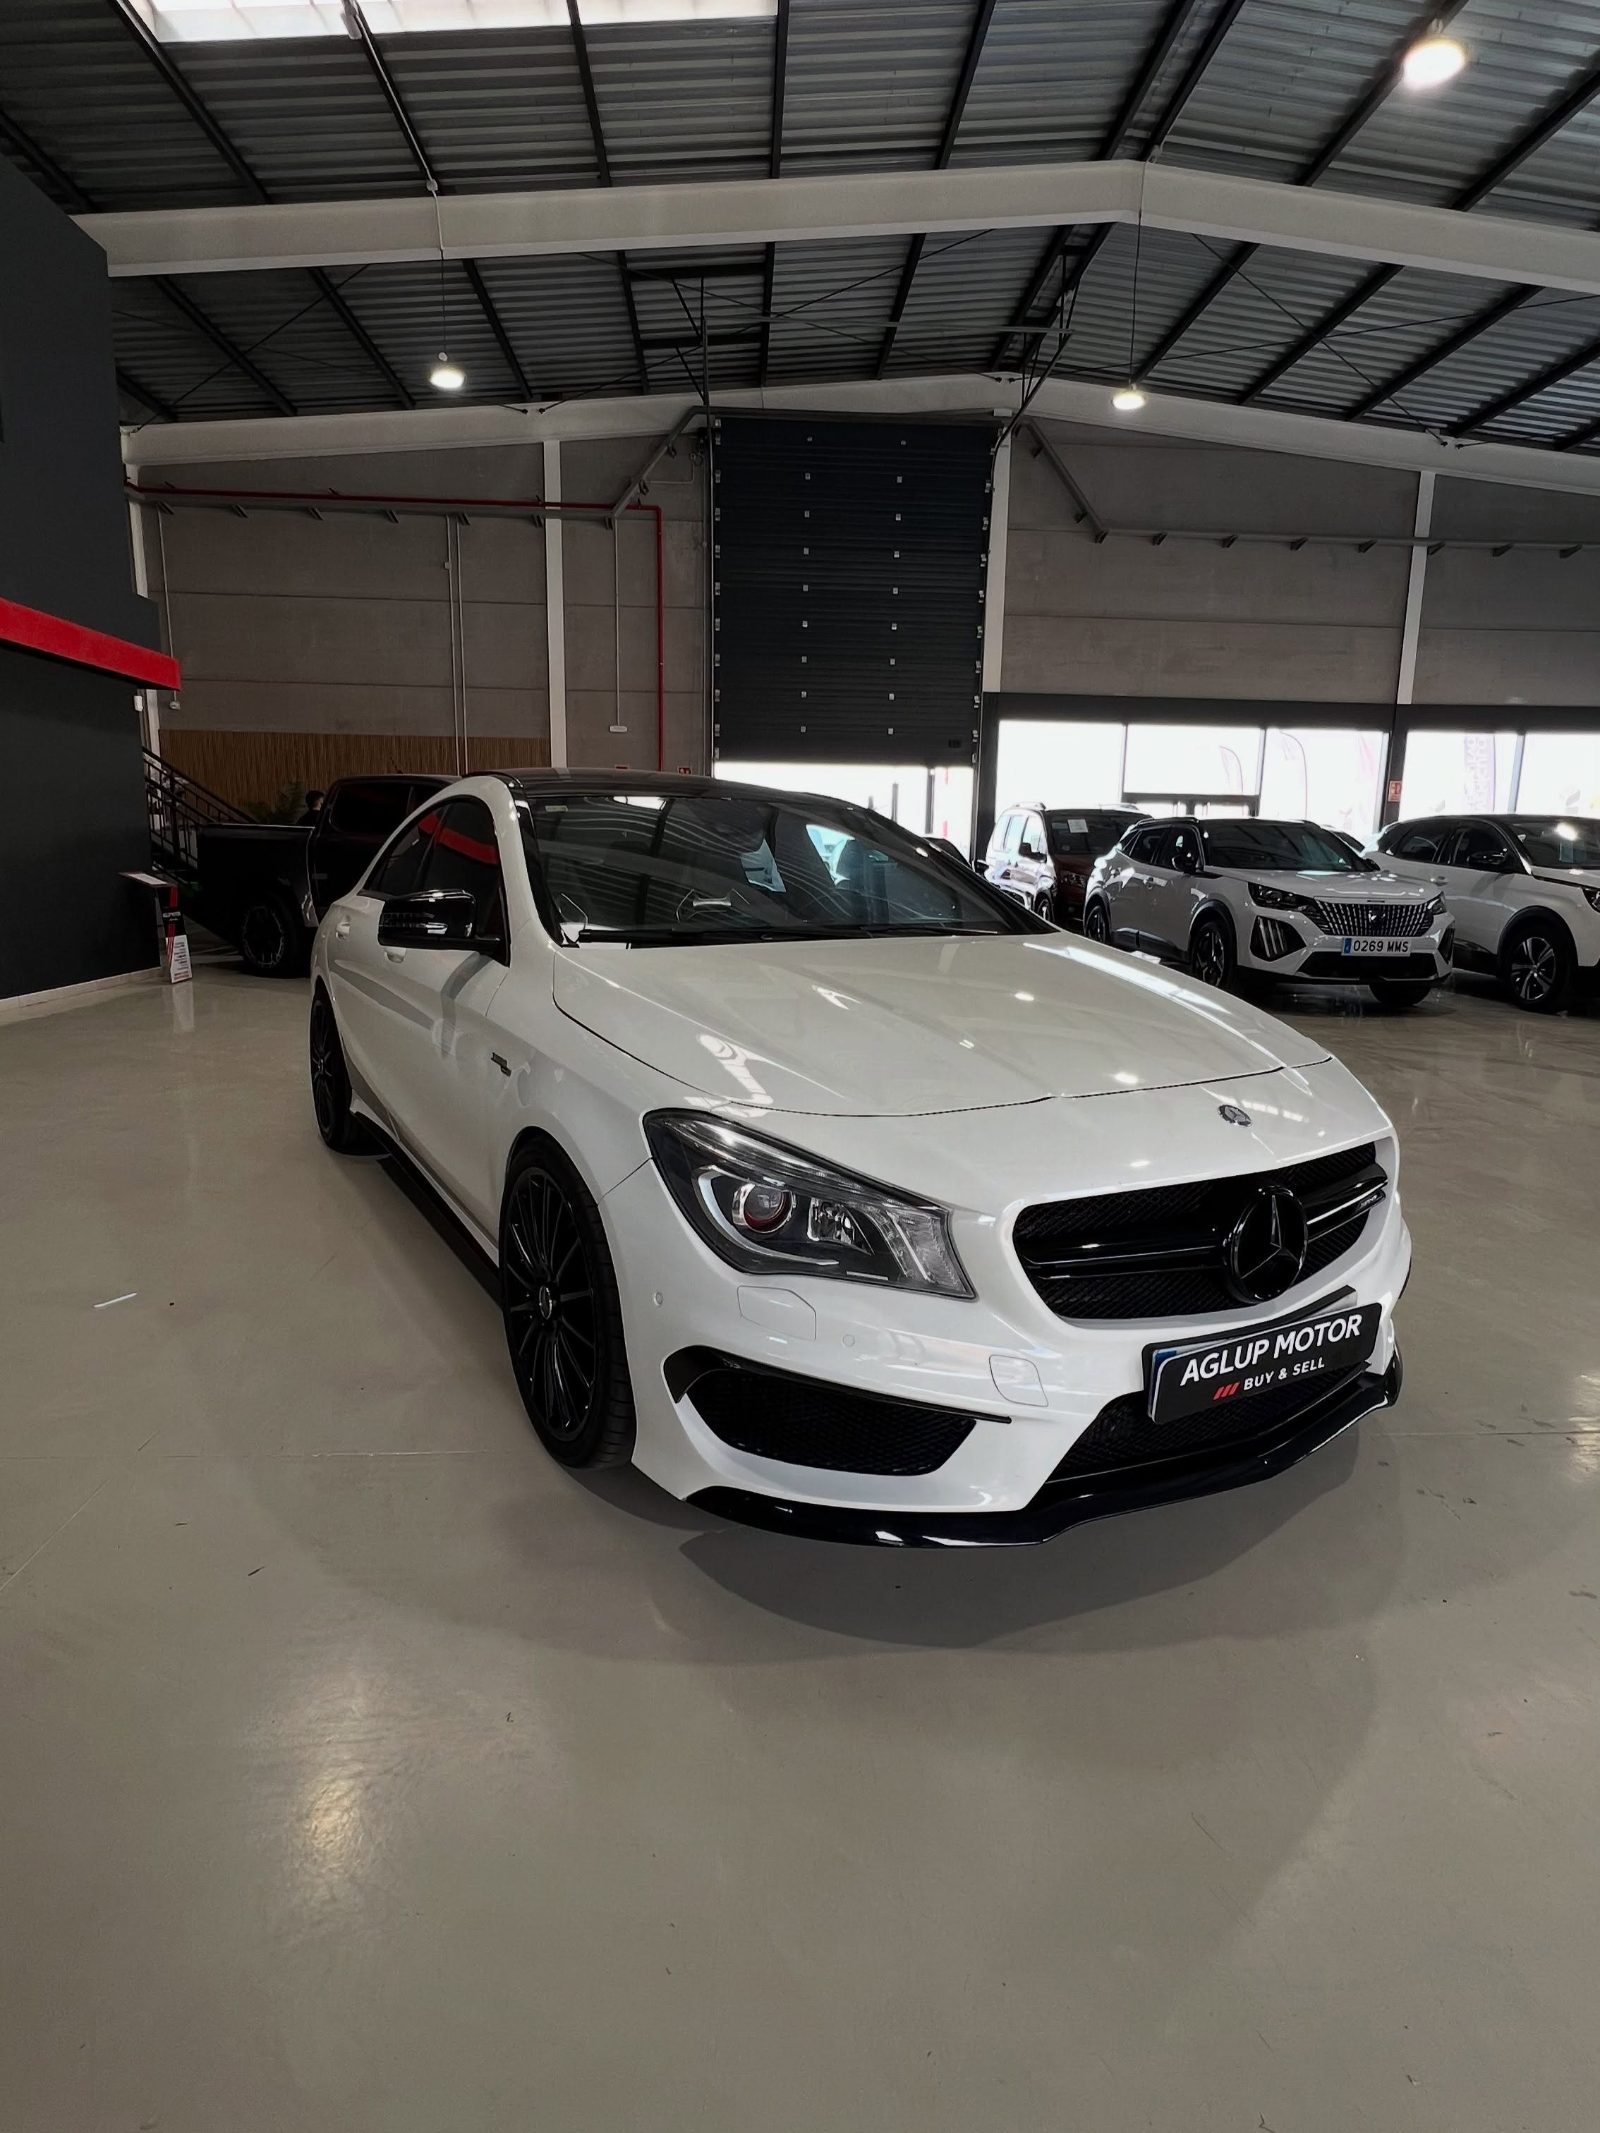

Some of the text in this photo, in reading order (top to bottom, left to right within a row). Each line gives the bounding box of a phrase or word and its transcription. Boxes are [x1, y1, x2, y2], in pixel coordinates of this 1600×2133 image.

[1353, 940, 1409, 953] 0269 MMS
[1180, 1314, 1363, 1386] AGLUP MOTOR
[1243, 1357, 1325, 1391] BUY & SELL
